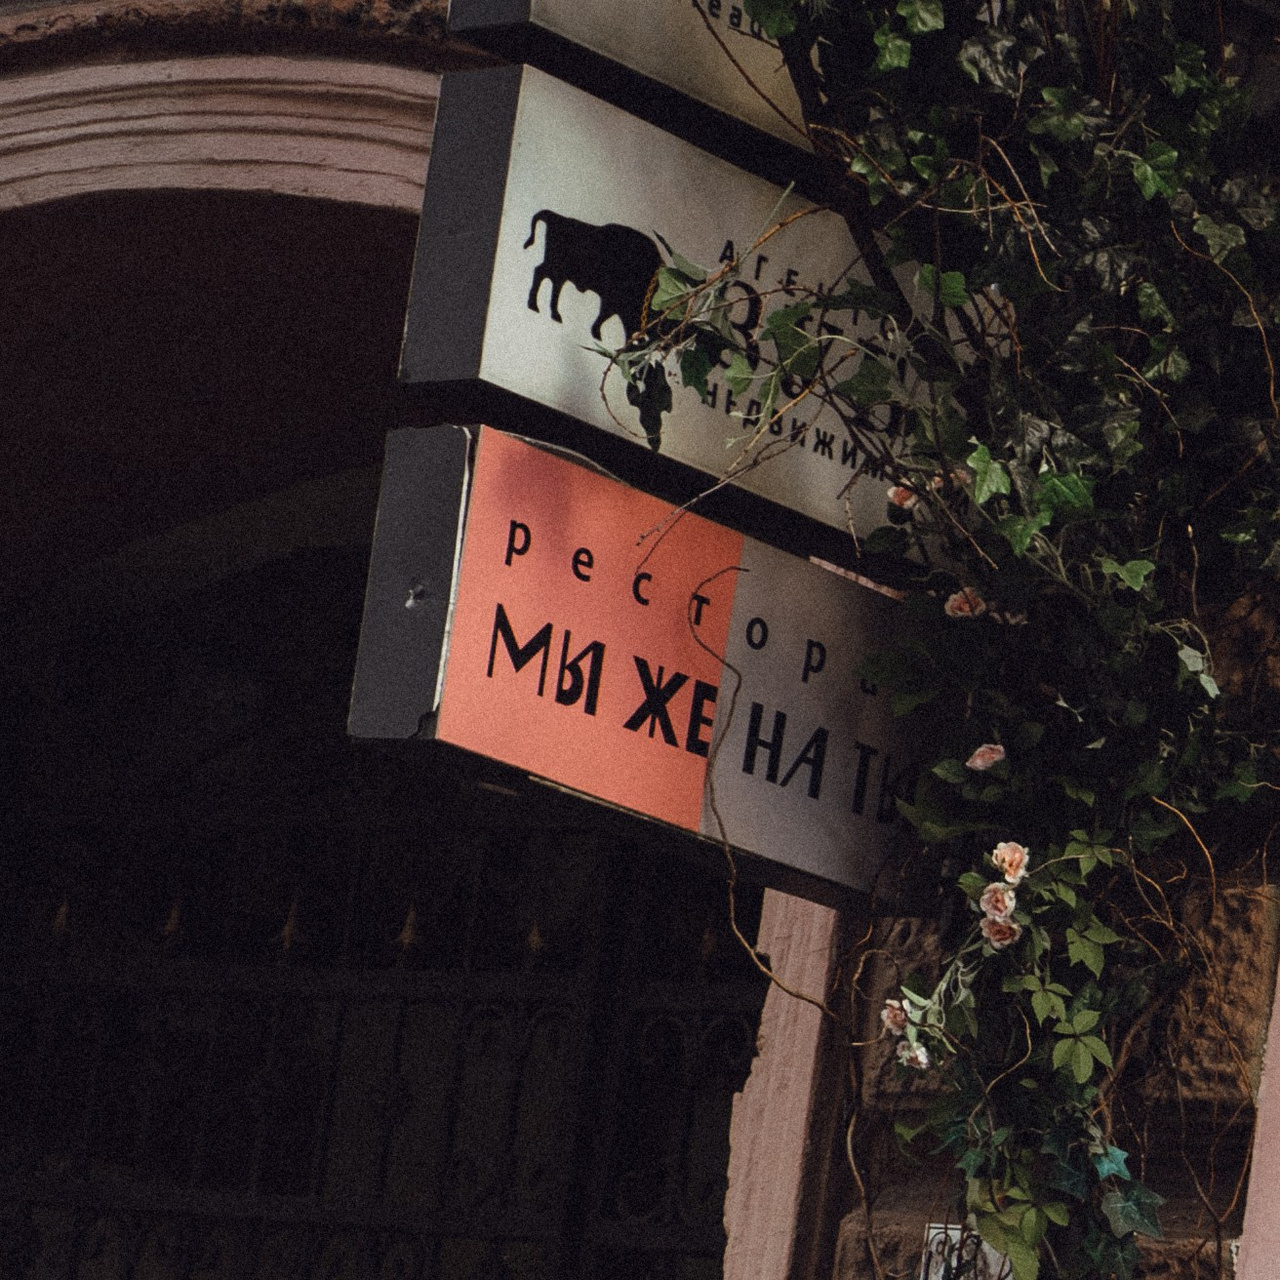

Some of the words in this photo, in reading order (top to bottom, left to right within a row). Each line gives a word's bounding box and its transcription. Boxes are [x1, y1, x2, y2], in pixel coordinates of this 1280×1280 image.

[487, 603, 606, 717] МЫ
[622, 655, 720, 759] ЖЕ
[741, 701, 830, 800] НА
